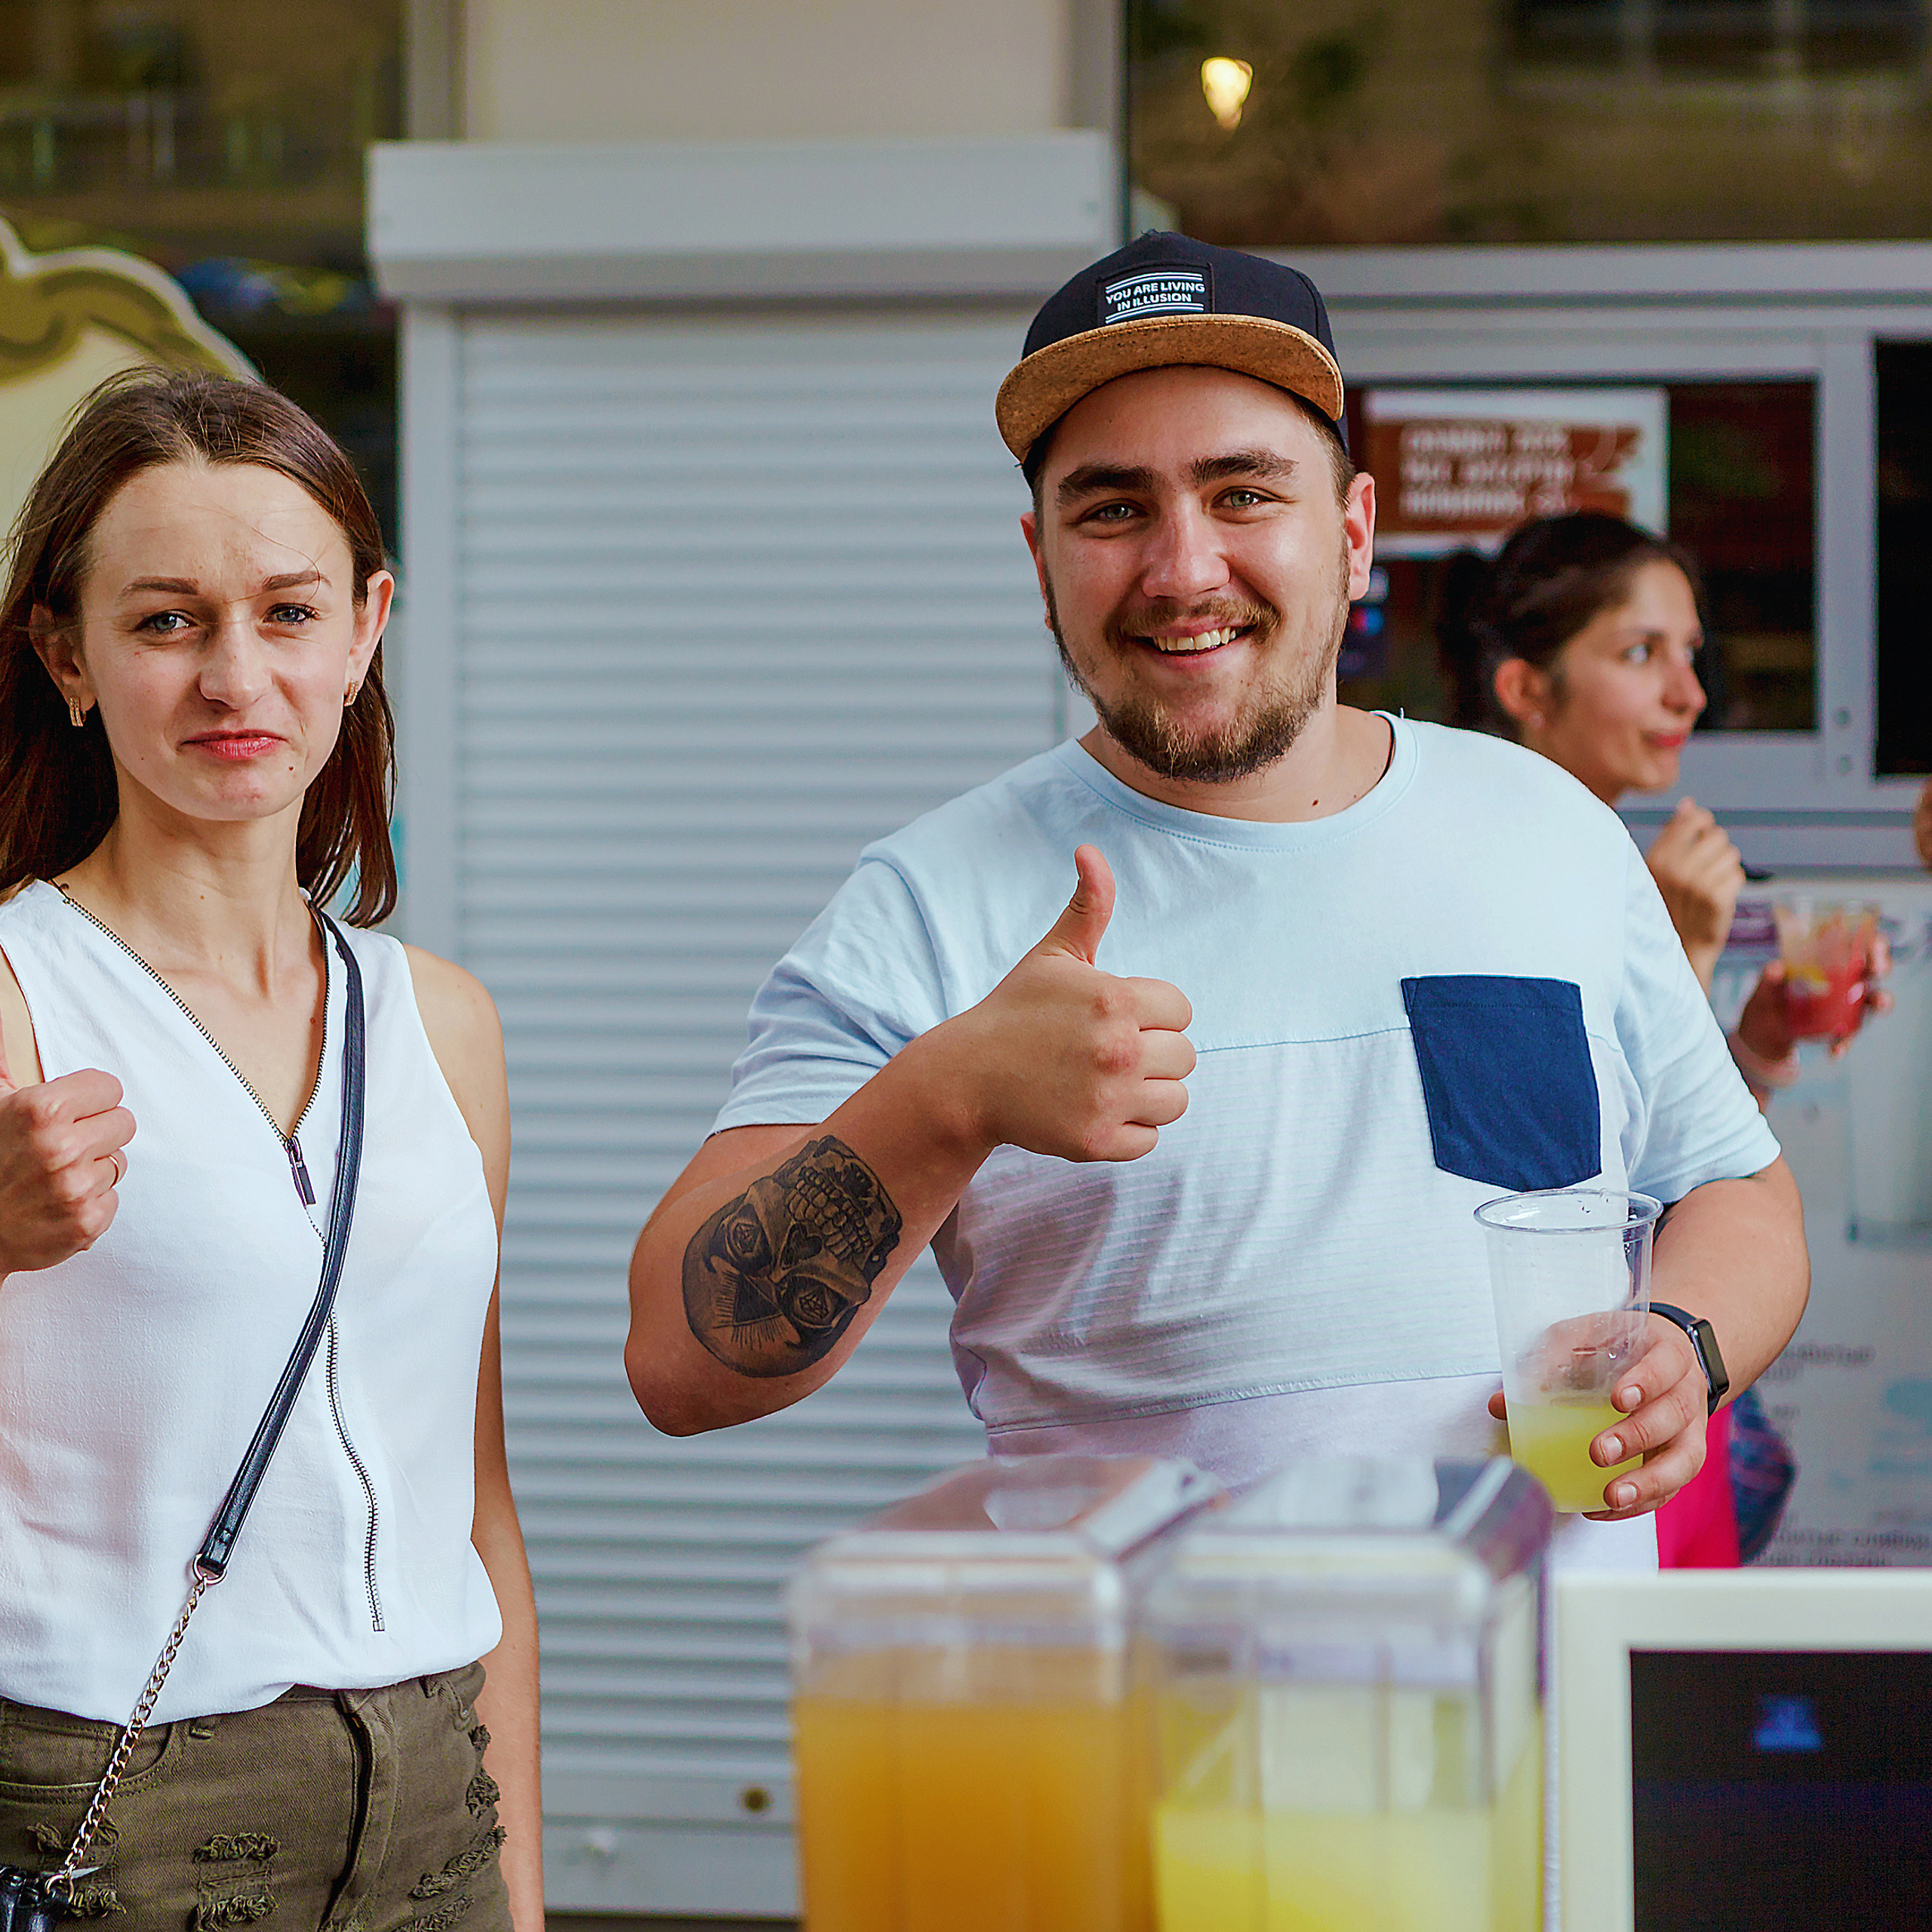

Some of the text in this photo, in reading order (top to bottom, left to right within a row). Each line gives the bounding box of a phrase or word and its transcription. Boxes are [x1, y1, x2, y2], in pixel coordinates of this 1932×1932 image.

[1106, 281, 1205, 304] YOU ARE LIVING
[1117, 293, 1192, 311] IN ILLUSION
